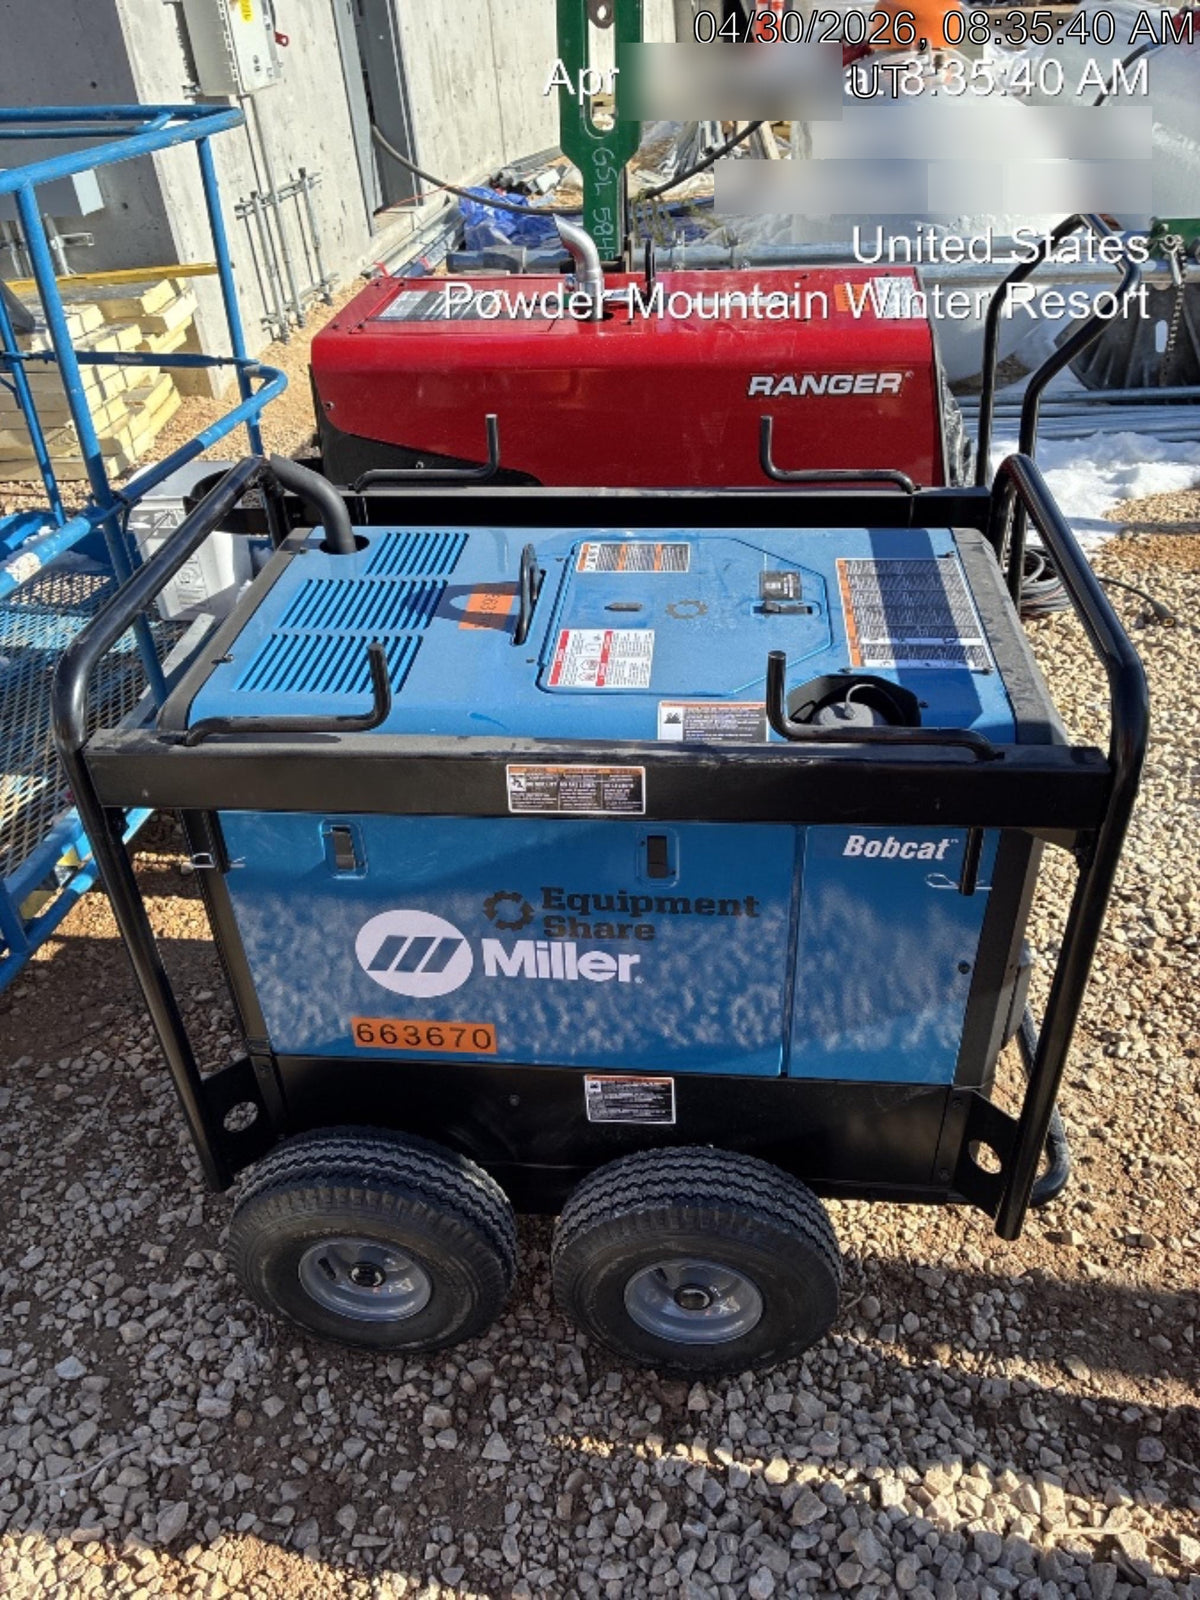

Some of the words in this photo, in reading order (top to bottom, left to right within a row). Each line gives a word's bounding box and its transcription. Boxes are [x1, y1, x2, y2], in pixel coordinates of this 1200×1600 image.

[748, 372, 903, 396] RANGER
[540, 886, 760, 918] Equipment
[543, 914, 656, 941] Share
[481, 938, 641, 983] Miller
[356, 1023, 492, 1050] 663670
